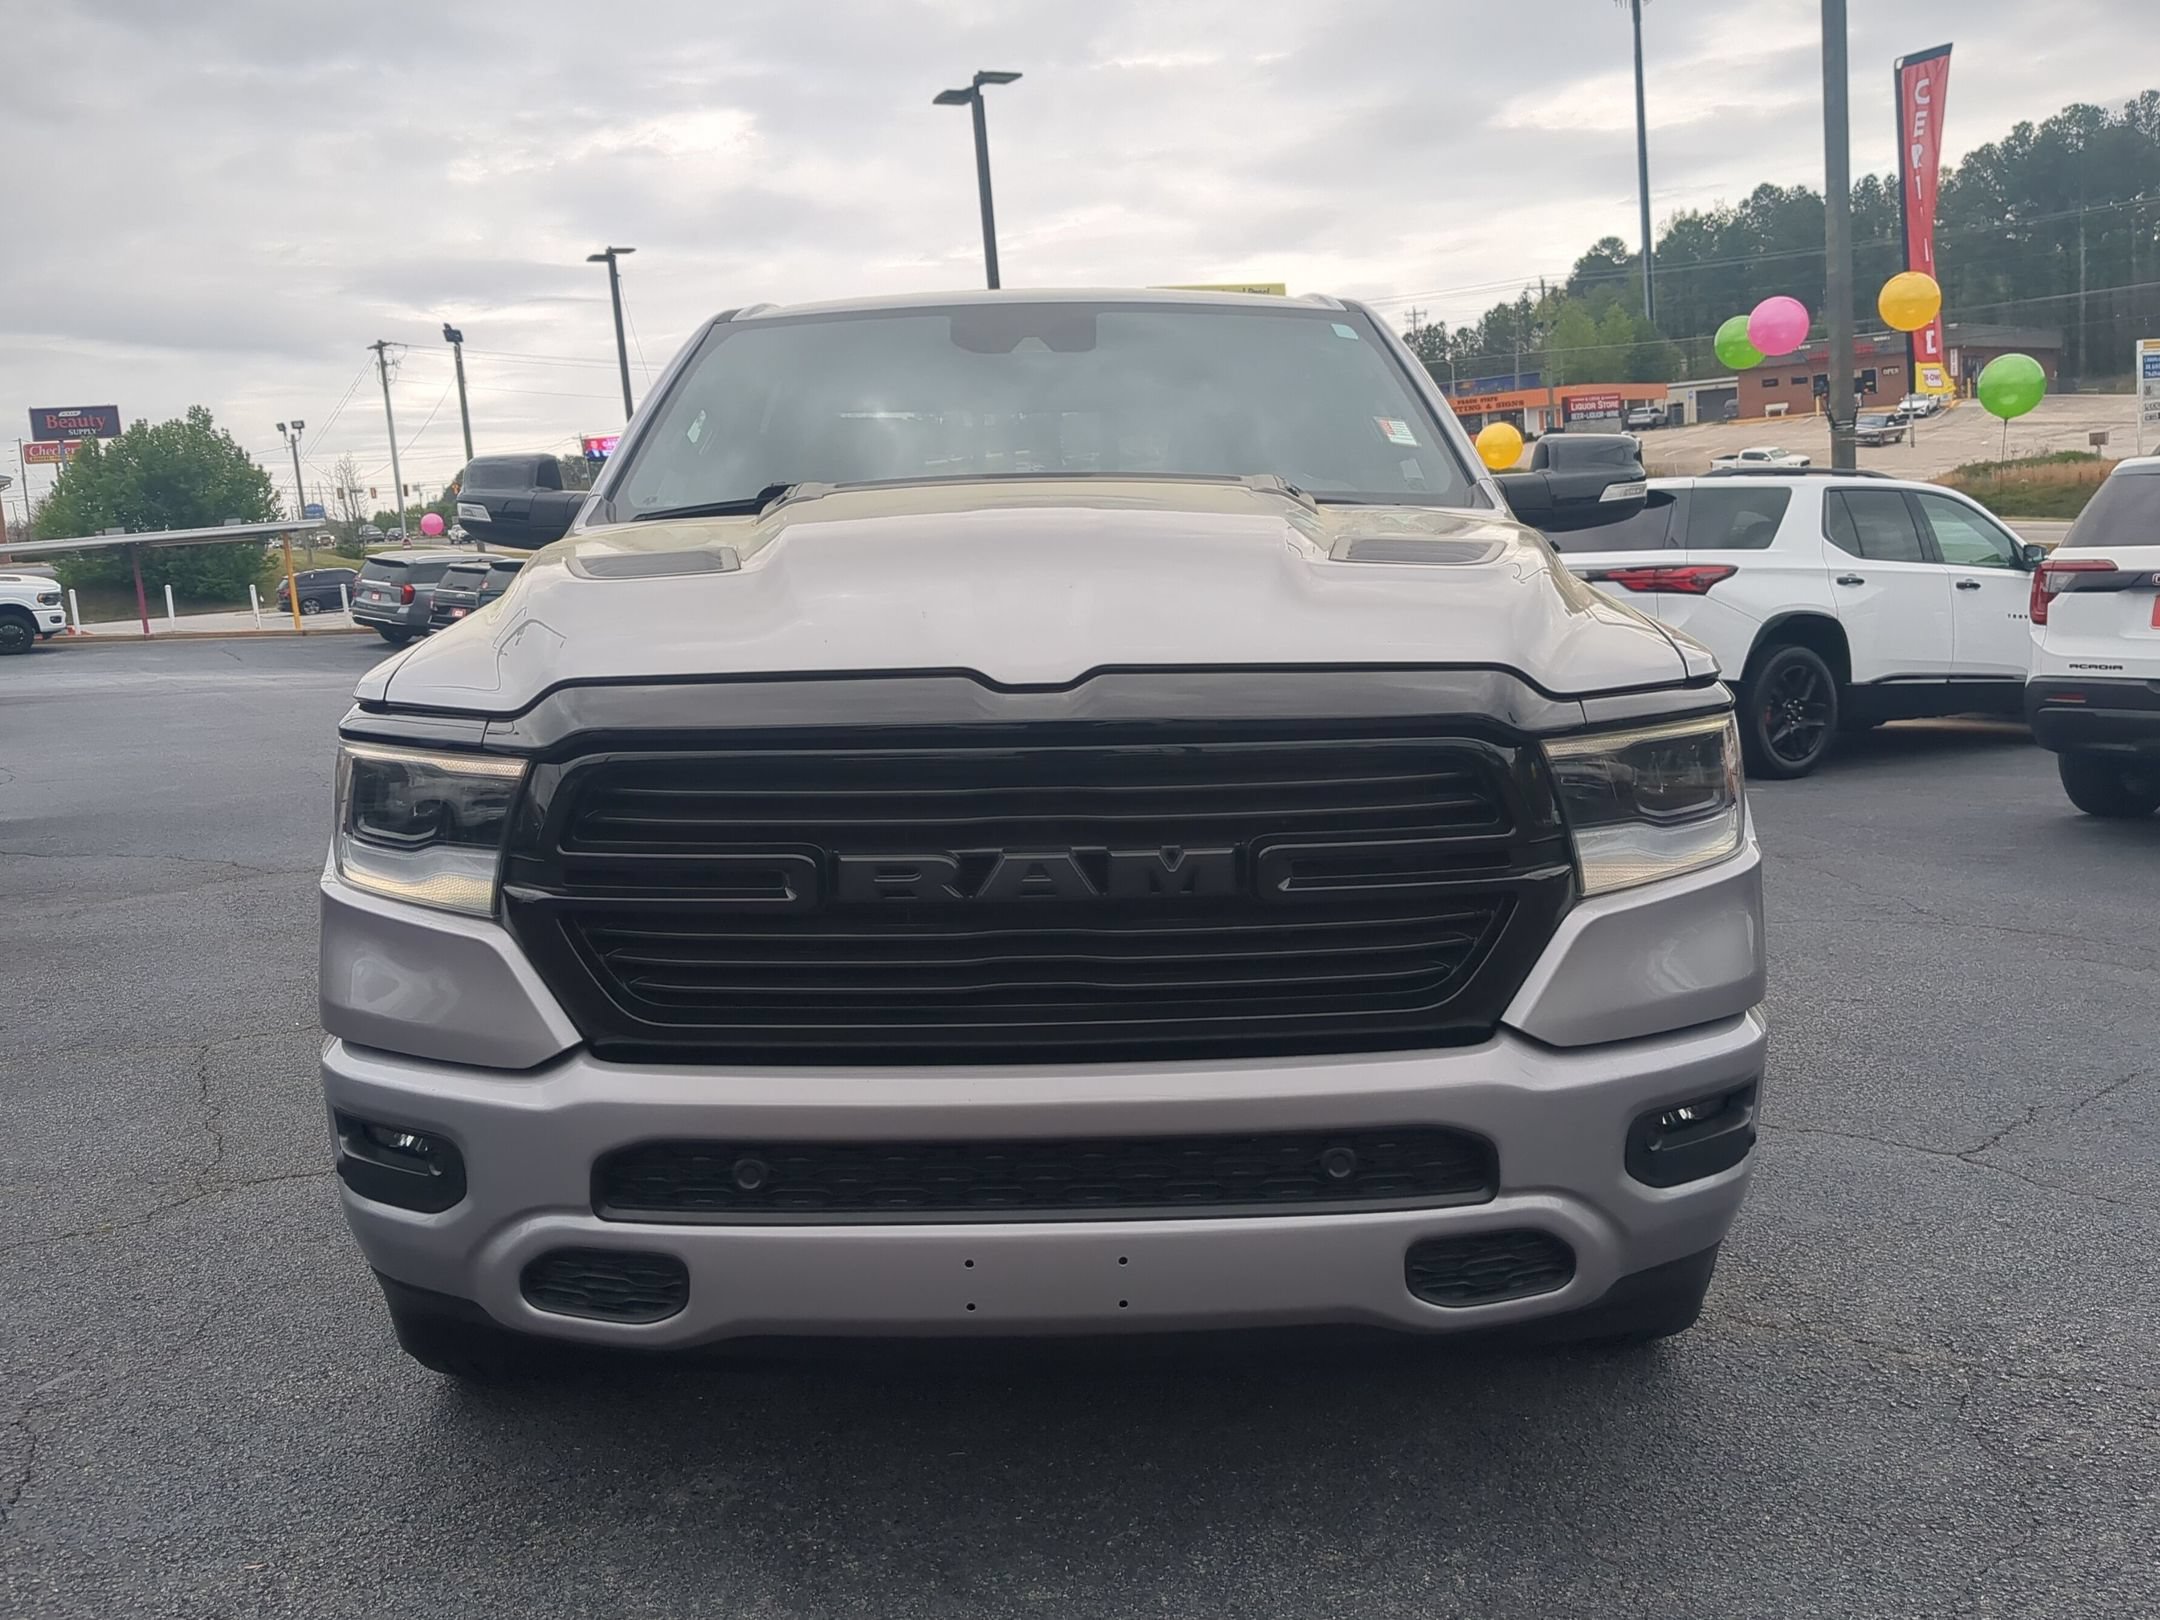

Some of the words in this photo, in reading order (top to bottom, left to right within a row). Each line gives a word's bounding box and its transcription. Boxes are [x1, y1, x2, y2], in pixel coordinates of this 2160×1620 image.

[1496, 400, 1525, 408] SIGNS
[1570, 401, 1596, 411] LIQUOR
[1597, 400, 1619, 410] STORE
[46, 414, 105, 431] Beauty
[68, 428, 97, 436] SUPPLY
[2068, 663, 2124, 671] ACADIA
[837, 847, 1237, 900] RAM
